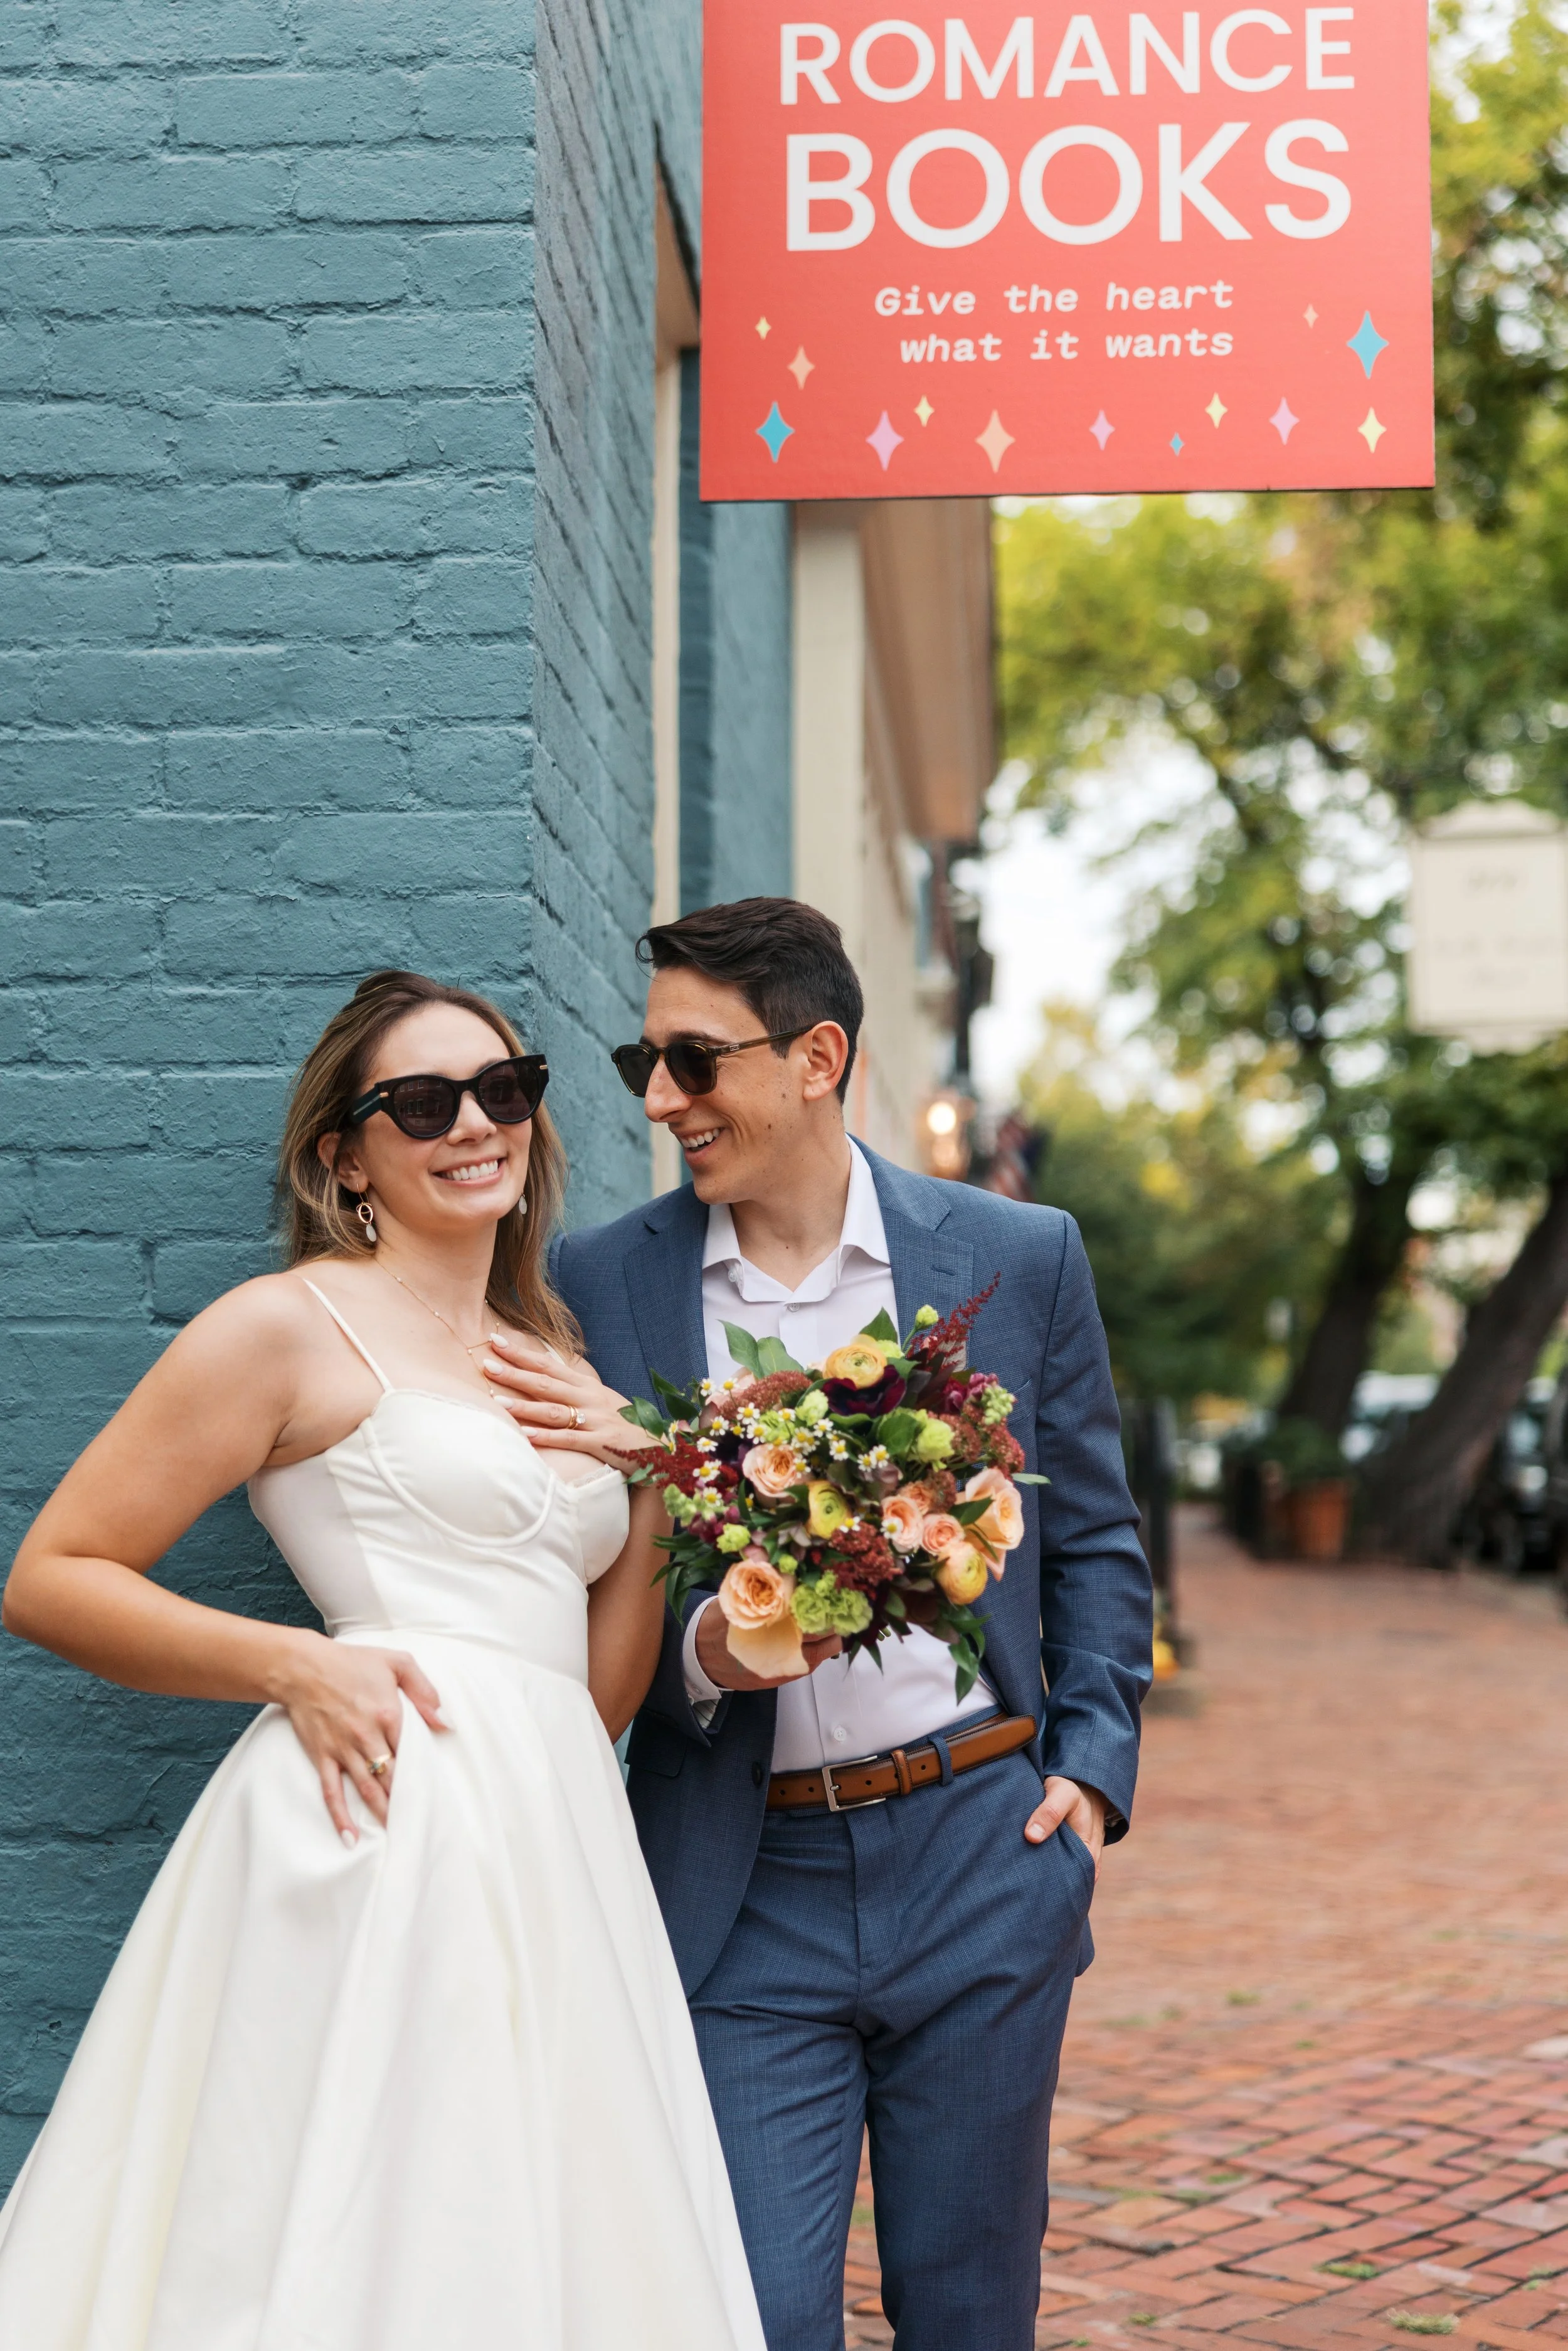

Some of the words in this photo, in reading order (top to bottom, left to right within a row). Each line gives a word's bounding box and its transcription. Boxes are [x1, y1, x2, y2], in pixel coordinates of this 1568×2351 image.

[780, 6, 1355, 105] ROMANCE
[787, 117, 1352, 252] BOOKS
[875, 285, 976, 316] Give
[1004, 284, 1078, 313] the
[1106, 280, 1234, 310] heart
[901, 333, 1002, 363] what
[1030, 329, 1079, 359] it
[1106, 328, 1233, 358] wants
